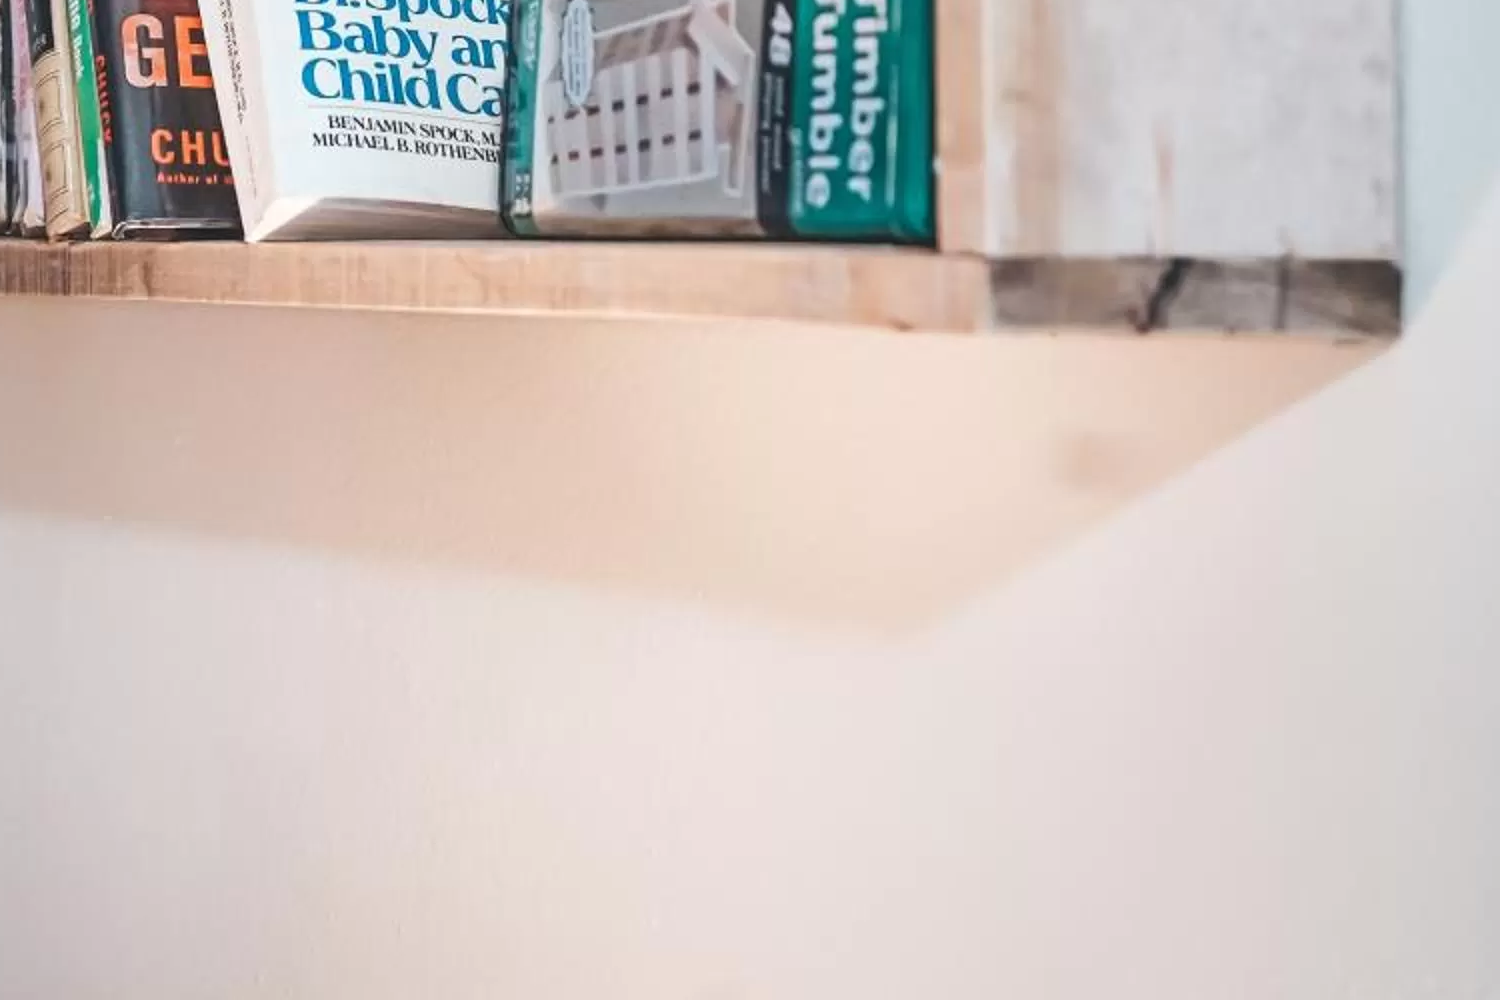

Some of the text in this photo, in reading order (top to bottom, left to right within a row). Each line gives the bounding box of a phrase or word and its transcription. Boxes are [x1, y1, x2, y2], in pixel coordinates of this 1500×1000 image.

[295, 9, 439, 70] Baby
[767, 1, 794, 68] 48
[301, 57, 443, 111] Child
[312, 132, 396, 152] MICHAEL
[398, 139, 414, 154] B.
[327, 114, 417, 137] BENJAMIN
[419, 123, 481, 145] SPOCK,
[157, 171, 200, 185] Author
